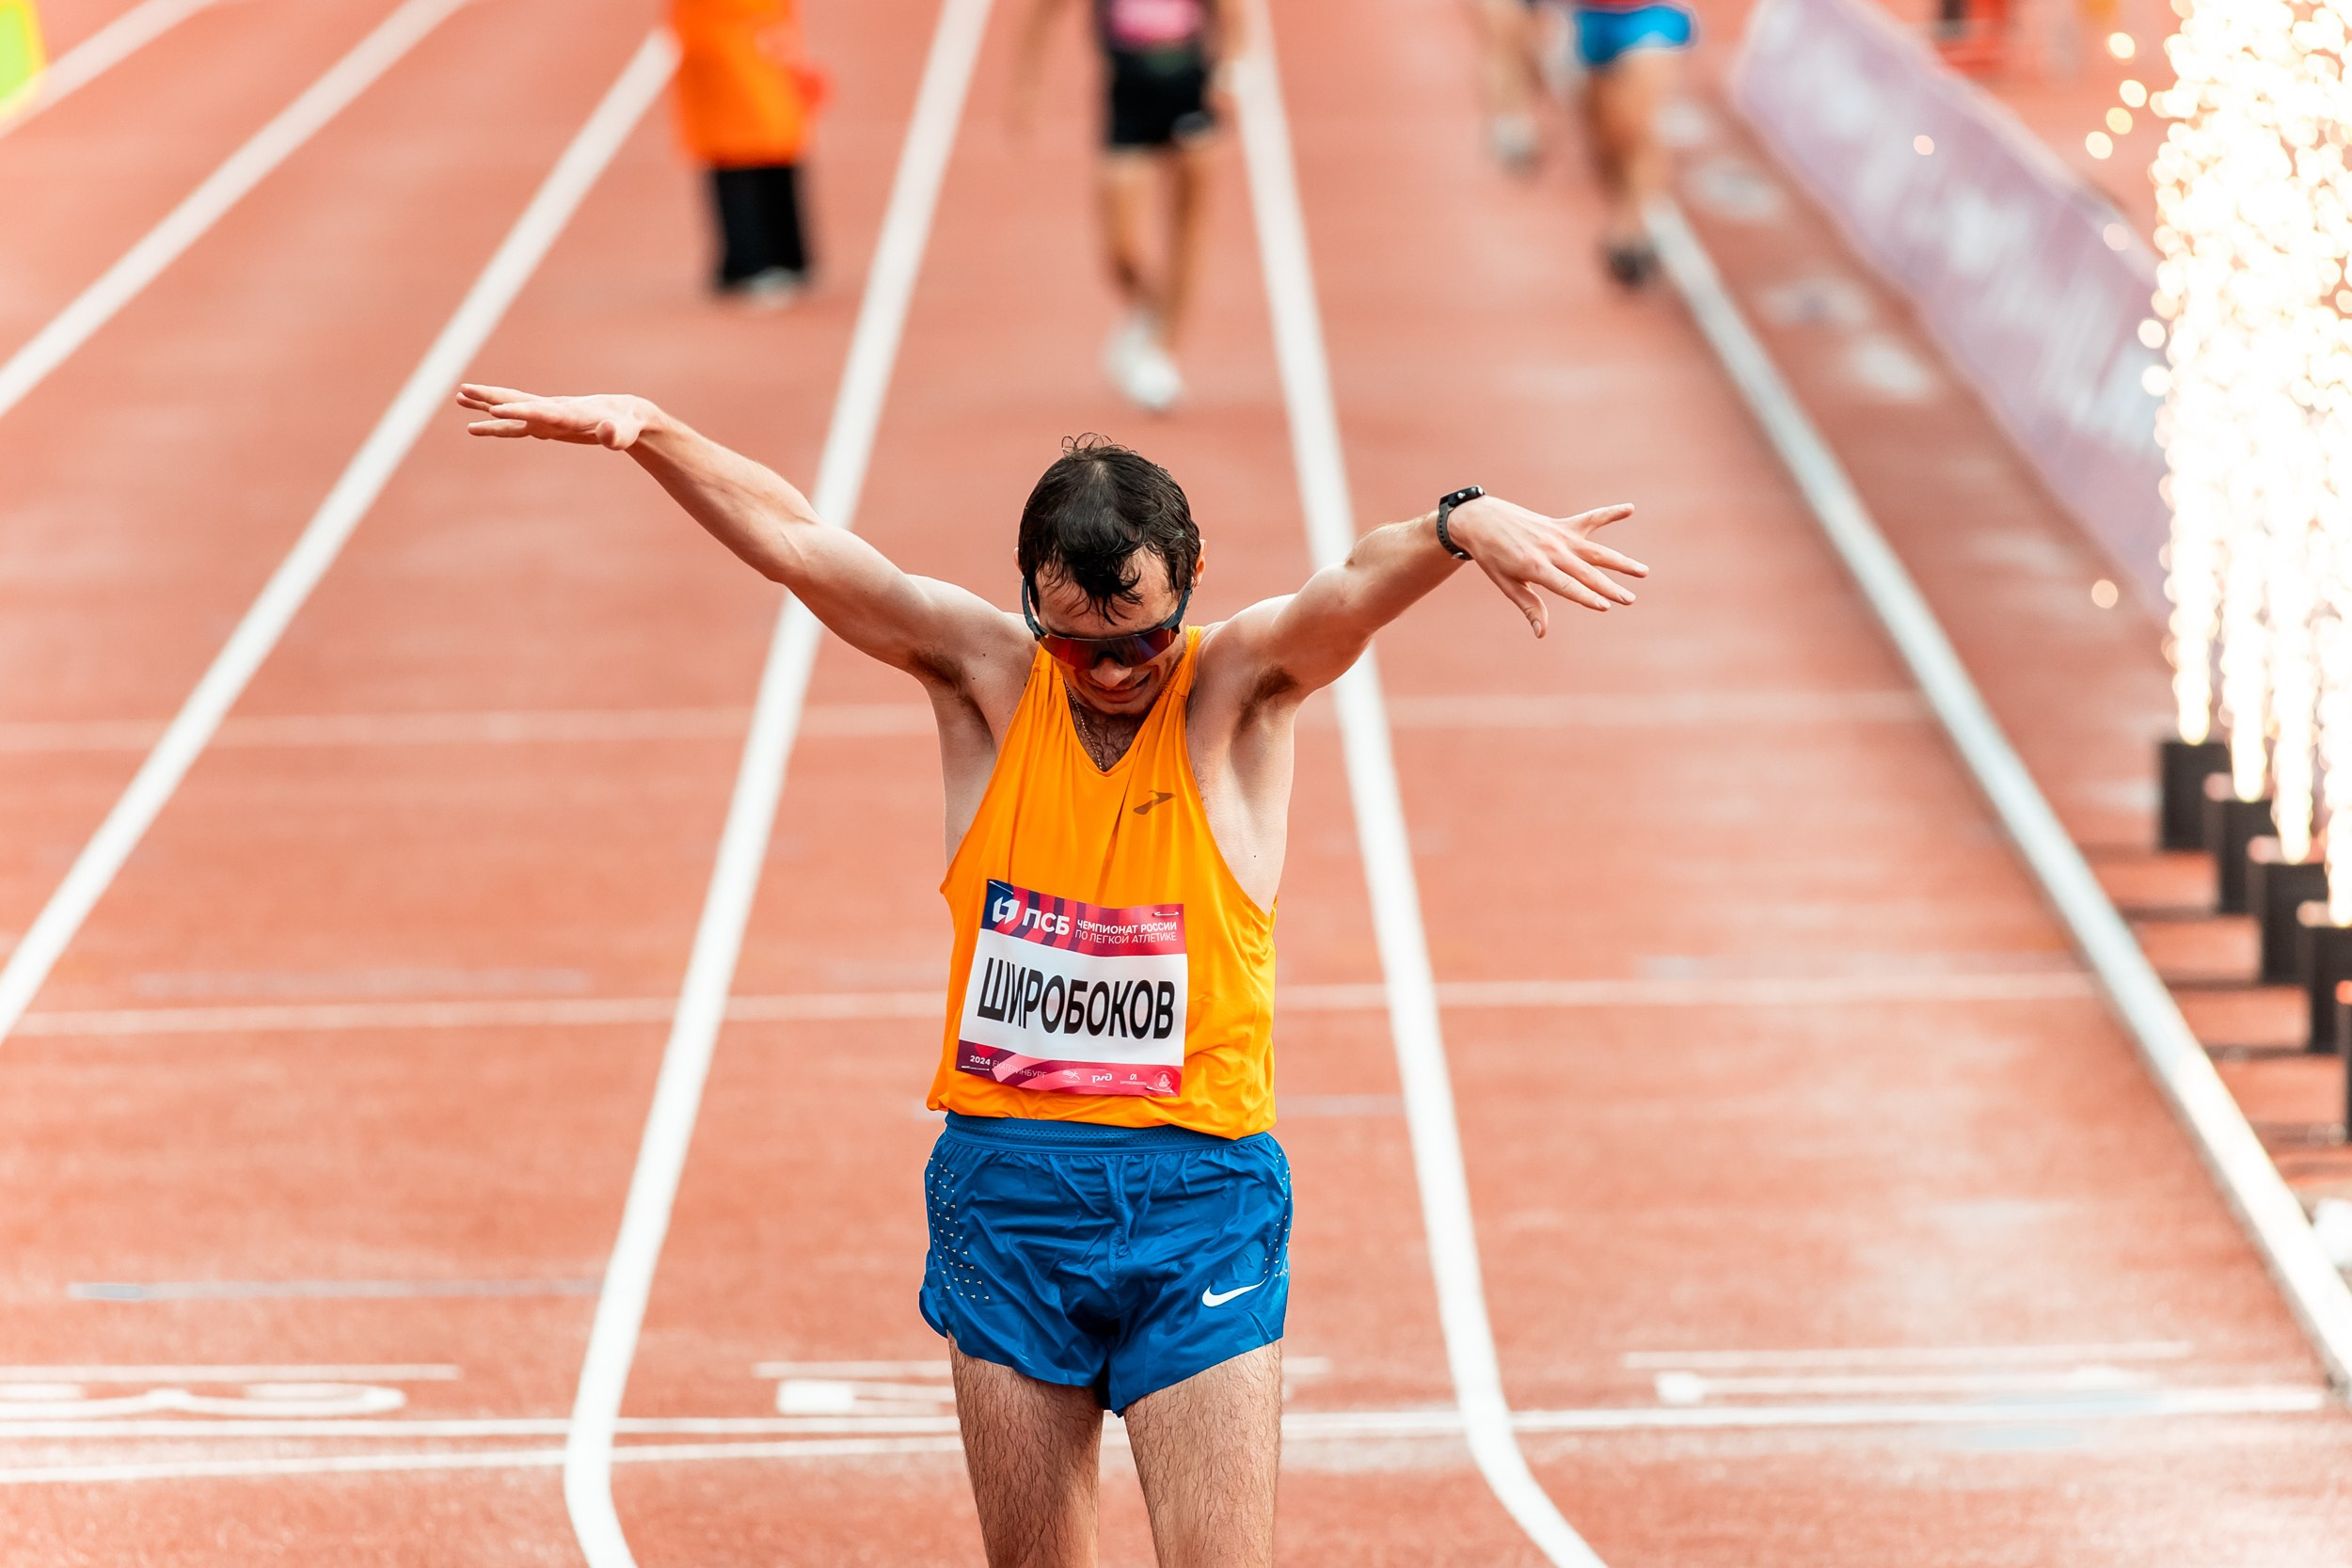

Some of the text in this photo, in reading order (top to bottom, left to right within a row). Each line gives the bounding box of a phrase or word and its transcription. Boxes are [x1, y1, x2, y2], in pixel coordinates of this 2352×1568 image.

[1022, 907, 1071, 936] ПСБ
[1077, 919, 1177, 935] ЧЕМПИОНАТ РОССИИ
[1074, 929, 1177, 944] ПО ЛЕГКОЙ АТЛЕТИКЕ
[977, 957, 1176, 1040] ШИРОБОКОВ
[970, 1054, 1047, 1079] 2024 ЕКАТЕРИНБУРГ
